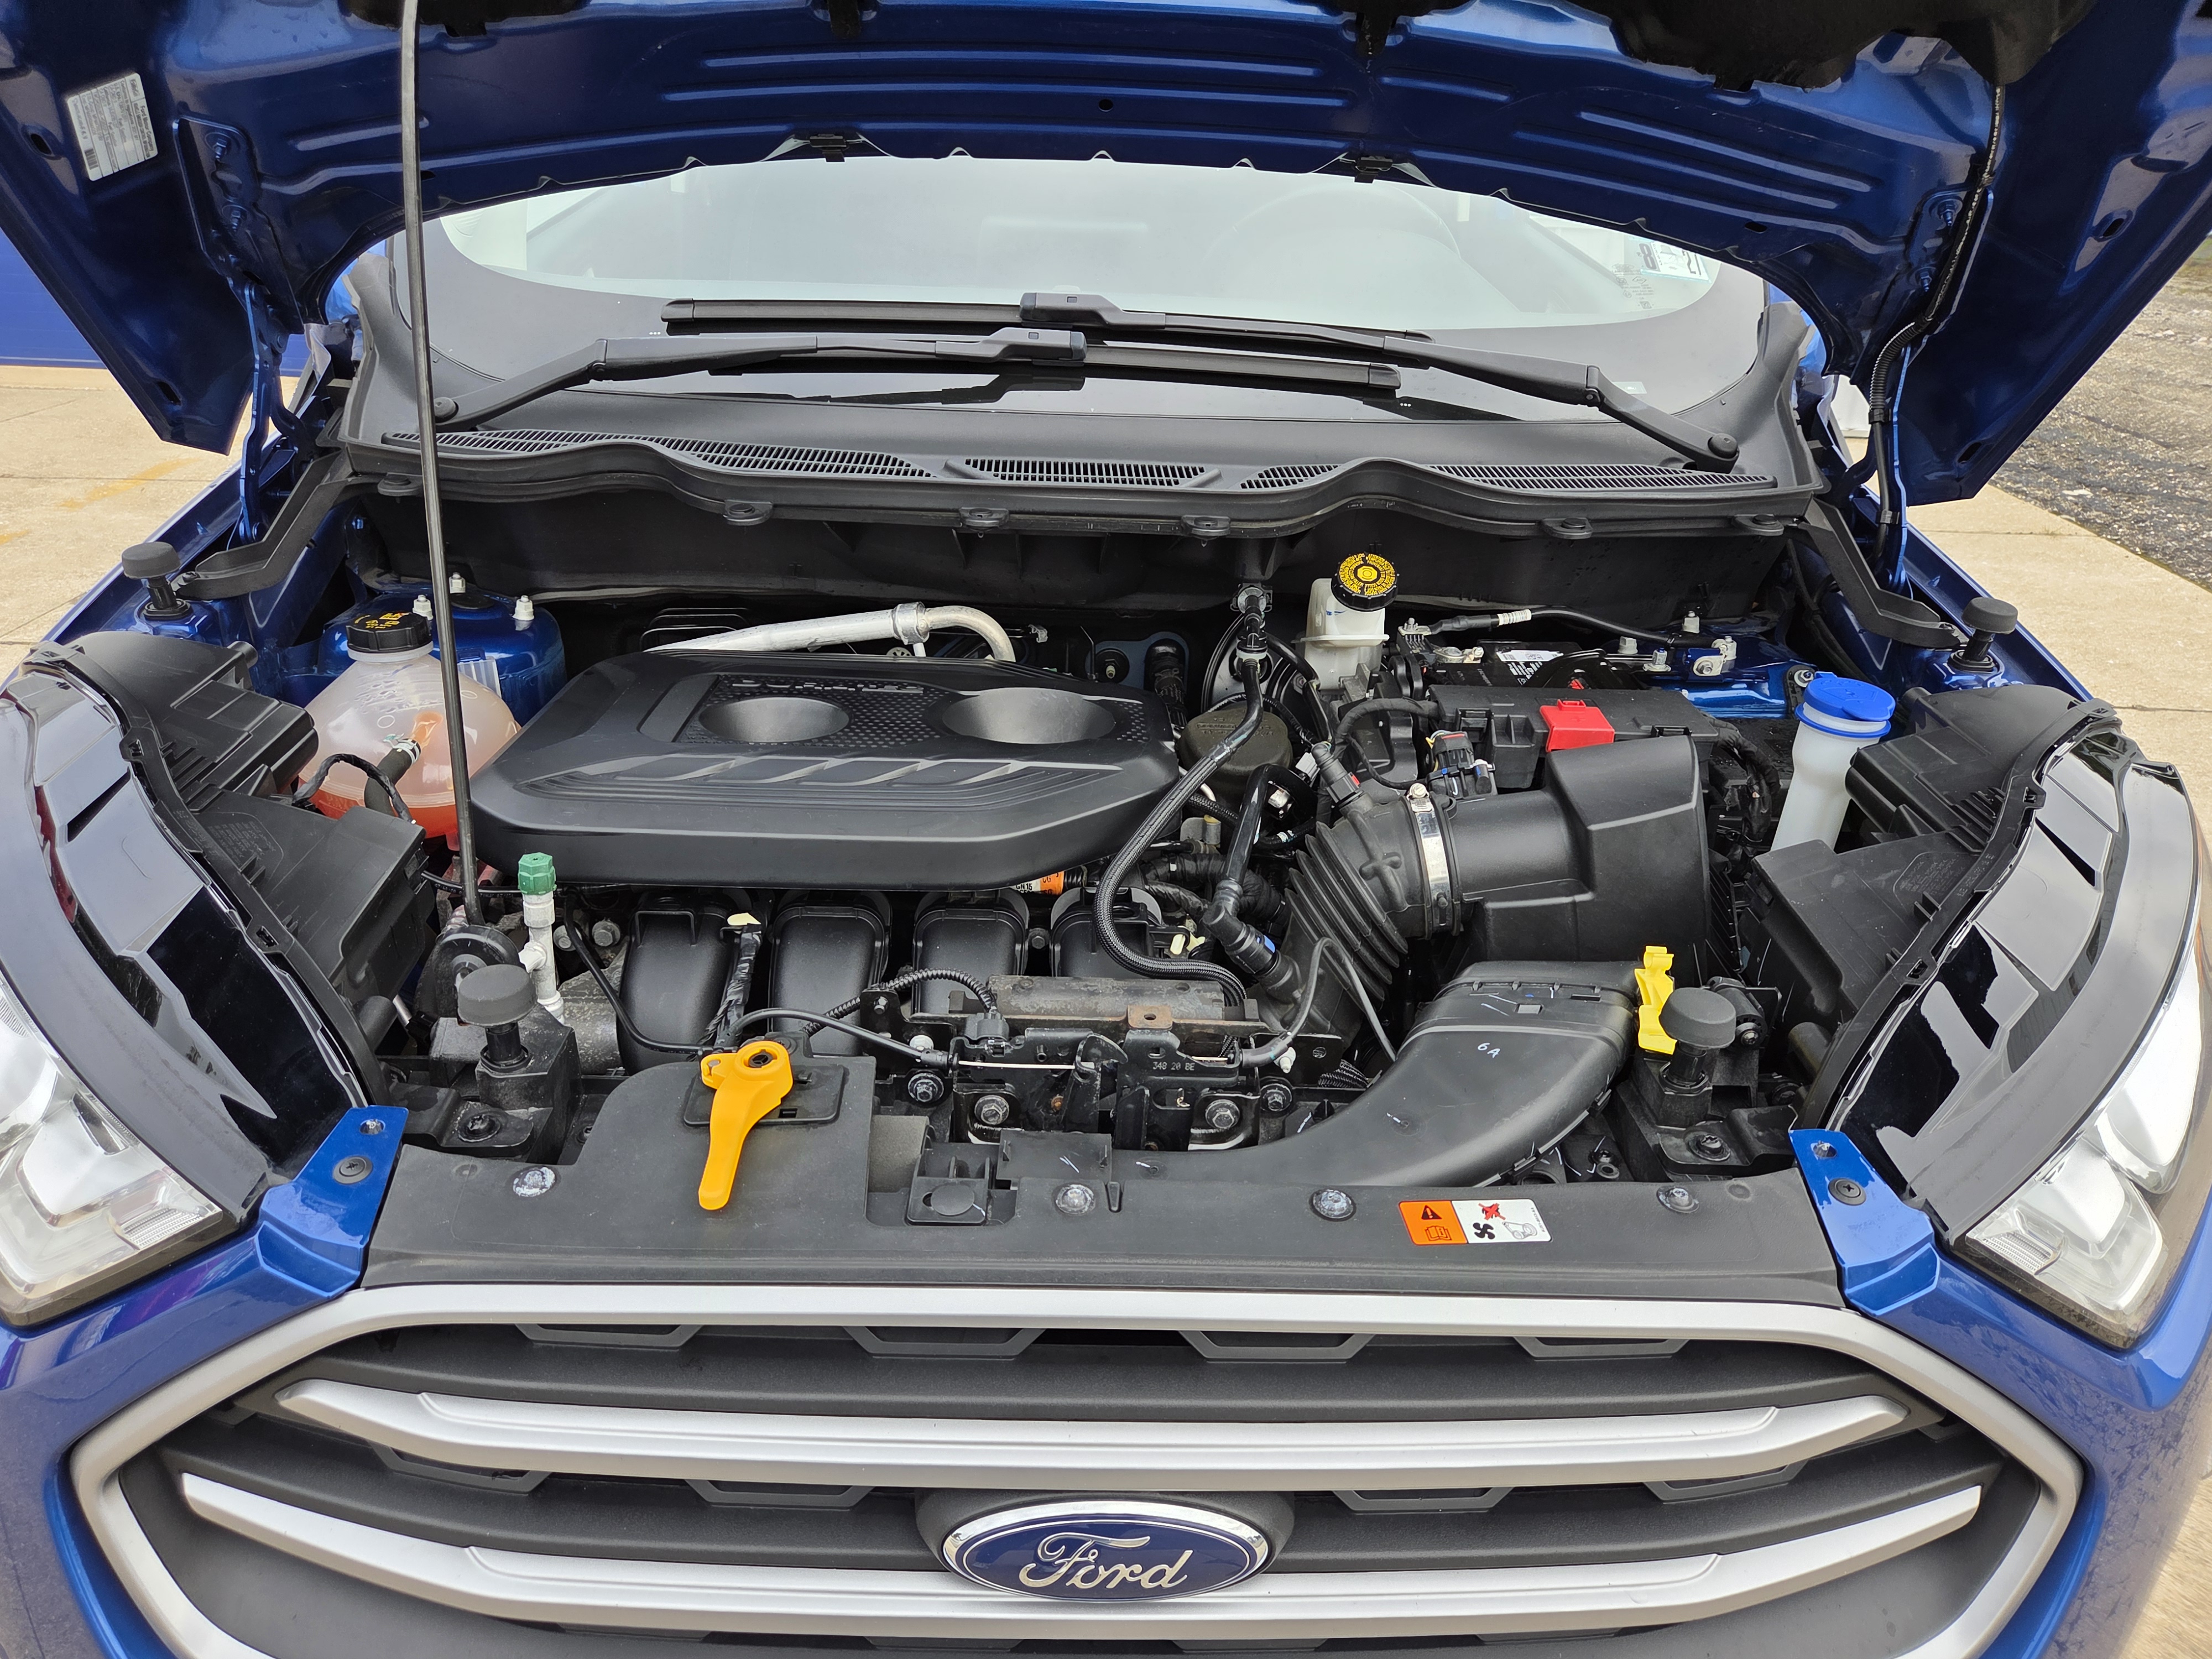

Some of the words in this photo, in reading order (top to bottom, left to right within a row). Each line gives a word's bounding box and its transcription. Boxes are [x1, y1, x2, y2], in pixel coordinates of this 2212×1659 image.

[144, 131, 155, 152] Company
[1639, 243, 1657, 270] 8
[1478, 1042, 1500, 1058] 6A
[1152, 1061, 1167, 1070] 348
[1019, 1532, 1193, 1589] Ford
